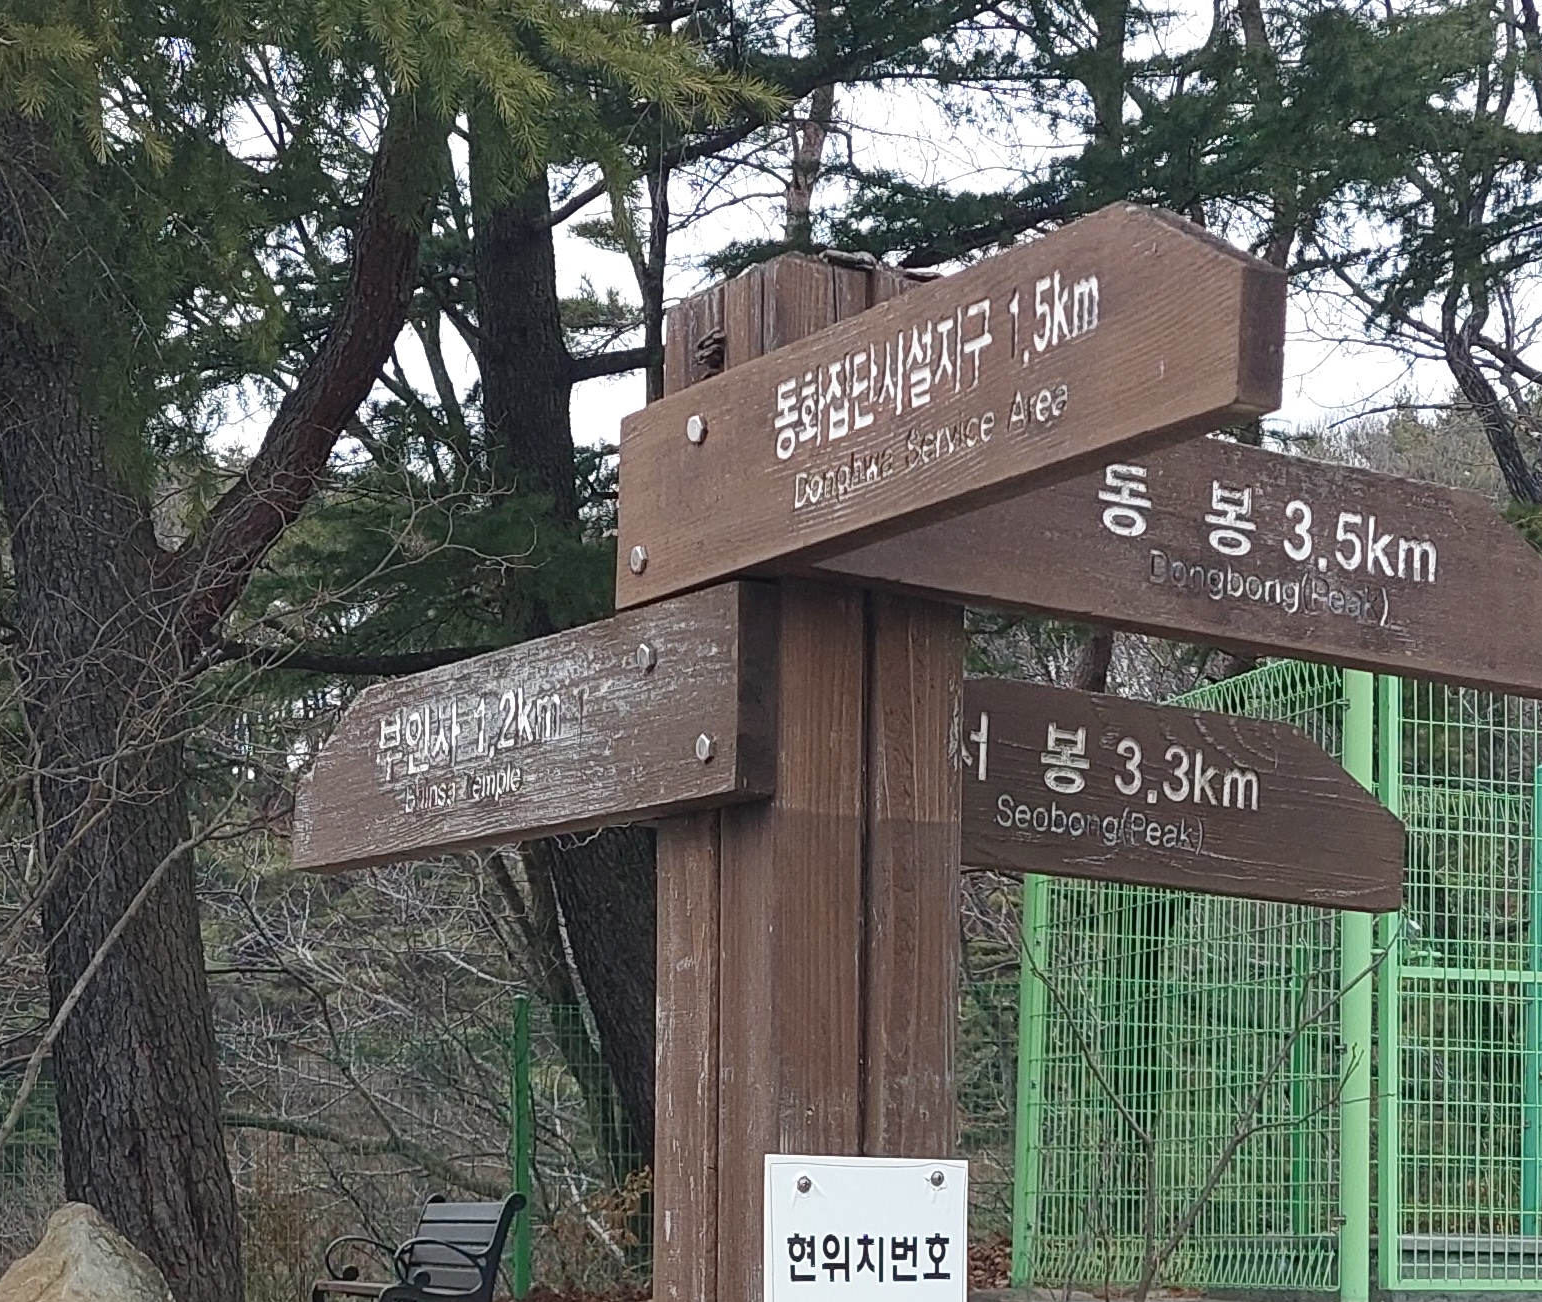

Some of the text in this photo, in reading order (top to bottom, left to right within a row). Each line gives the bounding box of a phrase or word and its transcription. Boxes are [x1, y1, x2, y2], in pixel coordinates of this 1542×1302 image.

[774, 270, 1099, 459] 동화집단시설지구 1.5km
[906, 409, 995, 468] Service
[1008, 384, 1069, 431] Area
[1283, 500, 1438, 583] 3.5km
[1149, 549, 1390, 627] Dongbong(Peak)
[377, 700, 459, 783] 부인사
[1114, 737, 1259, 811] 3.3km
[996, 794, 1204, 855] Seobong(Peak)
[787, 1233, 951, 1282] 현위치번호
